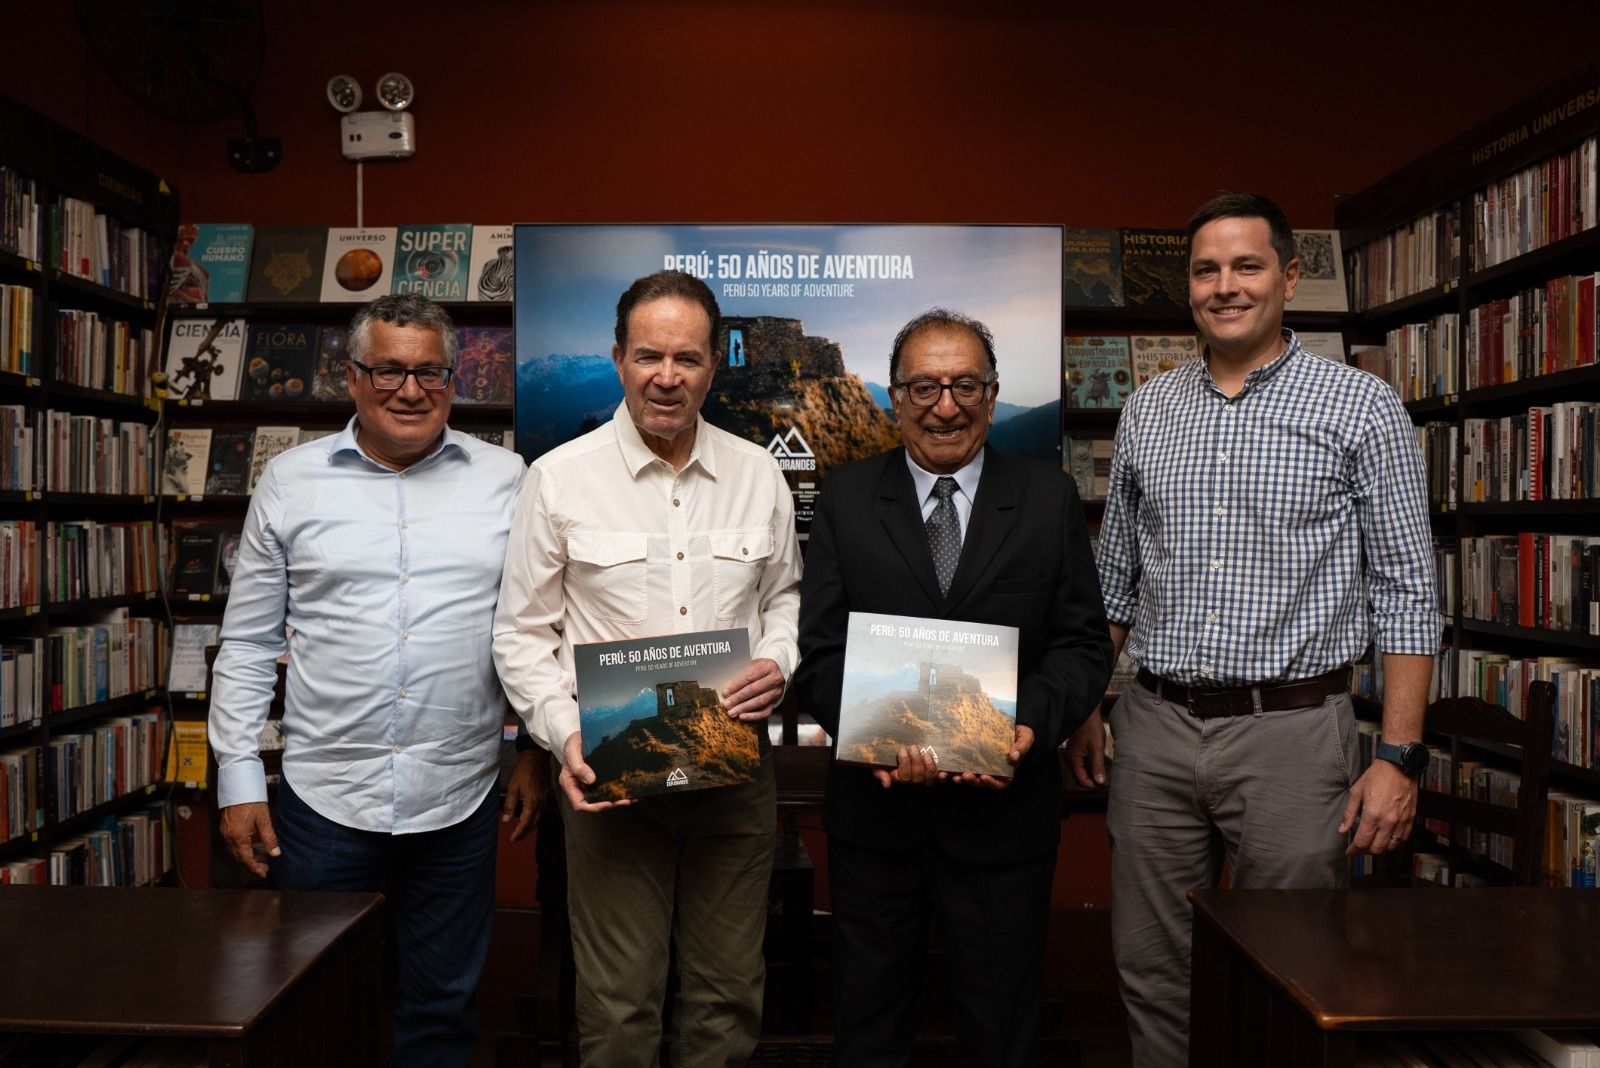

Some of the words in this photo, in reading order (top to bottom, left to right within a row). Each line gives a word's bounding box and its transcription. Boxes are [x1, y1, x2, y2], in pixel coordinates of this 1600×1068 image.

[1471, 125, 1529, 168] HISTORIA
[339, 233, 386, 242] UNIVERSO
[401, 231, 467, 251] SUPER
[1124, 234, 1188, 245] HISTORIA
[206, 246, 245, 255] CUERPO
[664, 251, 714, 279] PERÚ:
[718, 256, 741, 279] 50
[745, 251, 793, 279] AÑOS
[798, 255, 820, 279] DE
[823, 255, 914, 279] AVENTURA
[399, 281, 461, 297] CIENCIA
[748, 284, 760, 297] 50
[761, 284, 789, 297] YEARS
[791, 284, 802, 297] OF
[803, 284, 855, 297] ADVENTURE
[256, 332, 308, 346] FLORA
[1142, 352, 1192, 361] HISTORIA
[779, 458, 816, 471] ORANDES
[870, 623, 896, 638] PERÚ:
[898, 626, 911, 638] 50
[912, 627, 937, 641] AÑOS
[938, 630, 951, 642] DE
[952, 631, 999, 647] AVENTURA
[599, 650, 627, 667] PERÚ:
[628, 651, 641, 663] 50
[643, 646, 667, 661] AÑOS
[669, 646, 681, 659] DE
[683, 640, 731, 657] AVENTURA
